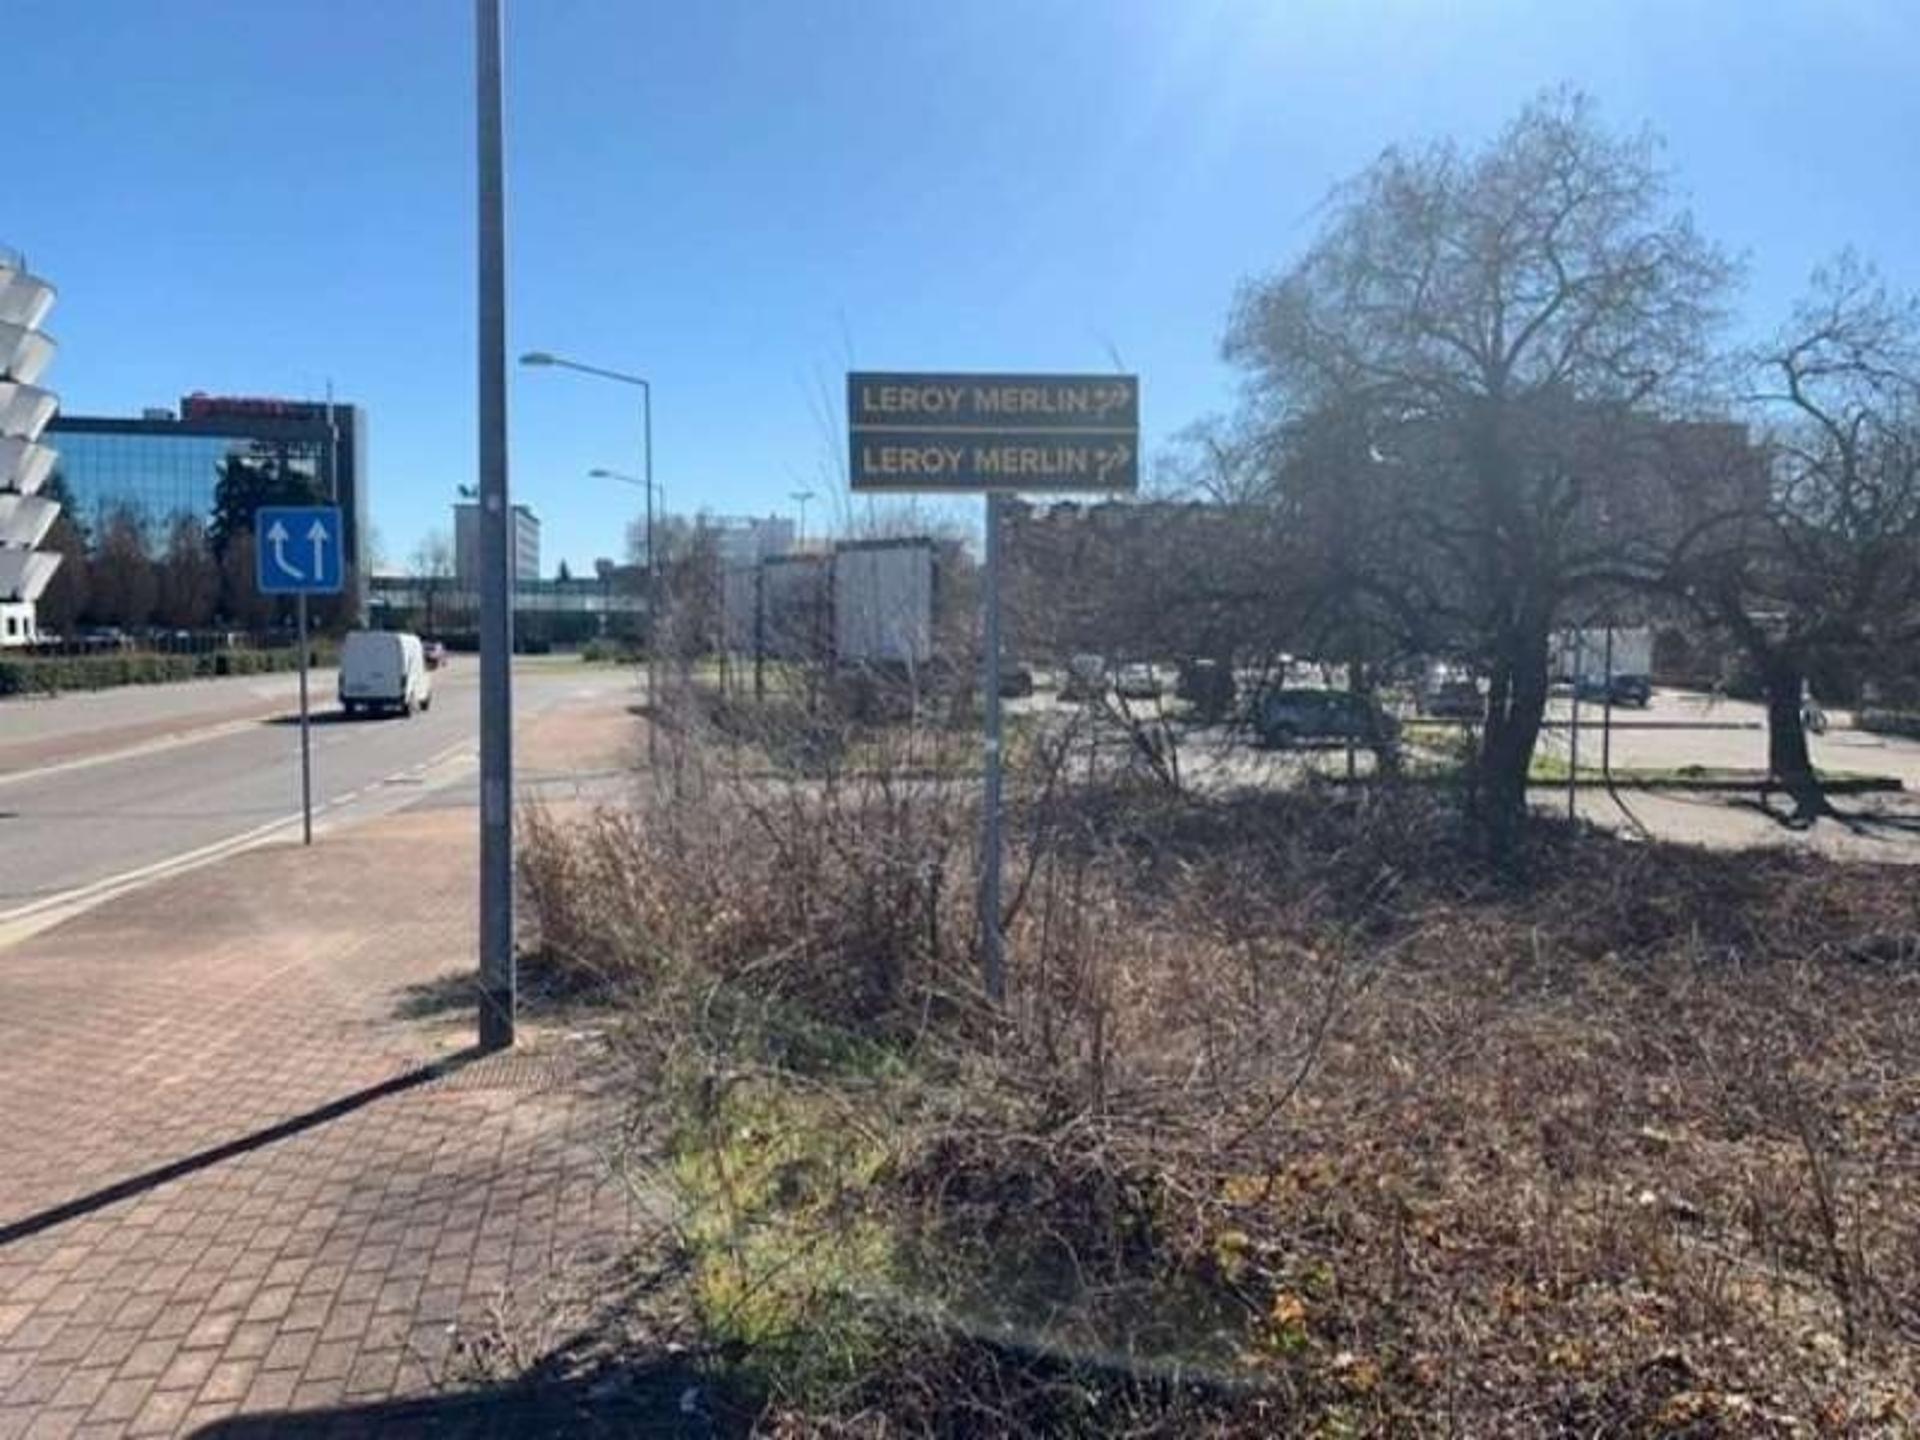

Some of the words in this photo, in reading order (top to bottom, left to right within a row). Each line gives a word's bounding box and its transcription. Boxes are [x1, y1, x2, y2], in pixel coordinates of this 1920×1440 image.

[863, 385, 962, 413] LEROY
[974, 386, 1089, 413] MERLIN
[863, 446, 962, 474] LEROY
[974, 447, 1088, 474] MERLIN
